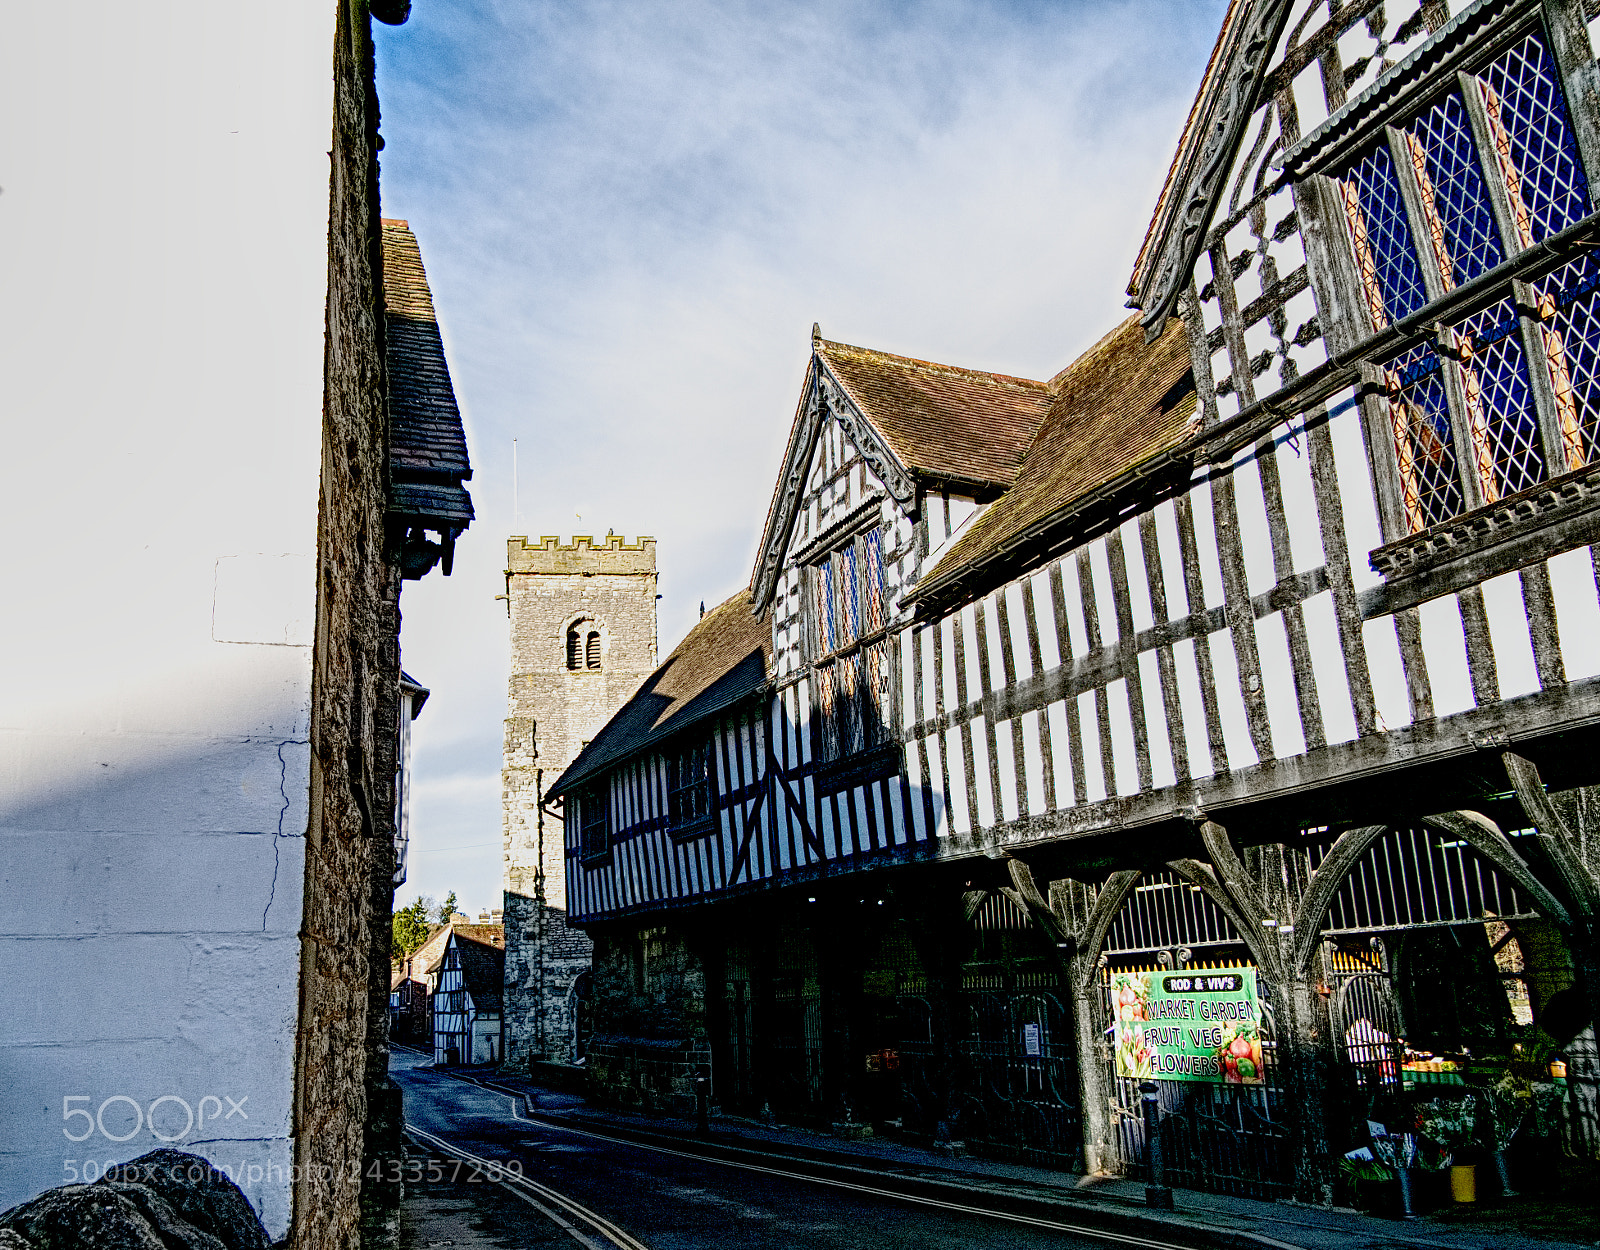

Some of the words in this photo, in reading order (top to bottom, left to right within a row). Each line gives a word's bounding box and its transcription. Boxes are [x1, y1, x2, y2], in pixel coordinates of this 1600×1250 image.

[1170, 978, 1191, 991] ROD
[1194, 978, 1203, 990] &
[1207, 977, 1235, 990] VIV'S
[1147, 999, 1195, 1020] MARKET
[1144, 1027, 1185, 1049] FRUIT,
[1190, 1028, 1222, 1047] VEG
[1150, 1054, 1220, 1075] FLOWERS
